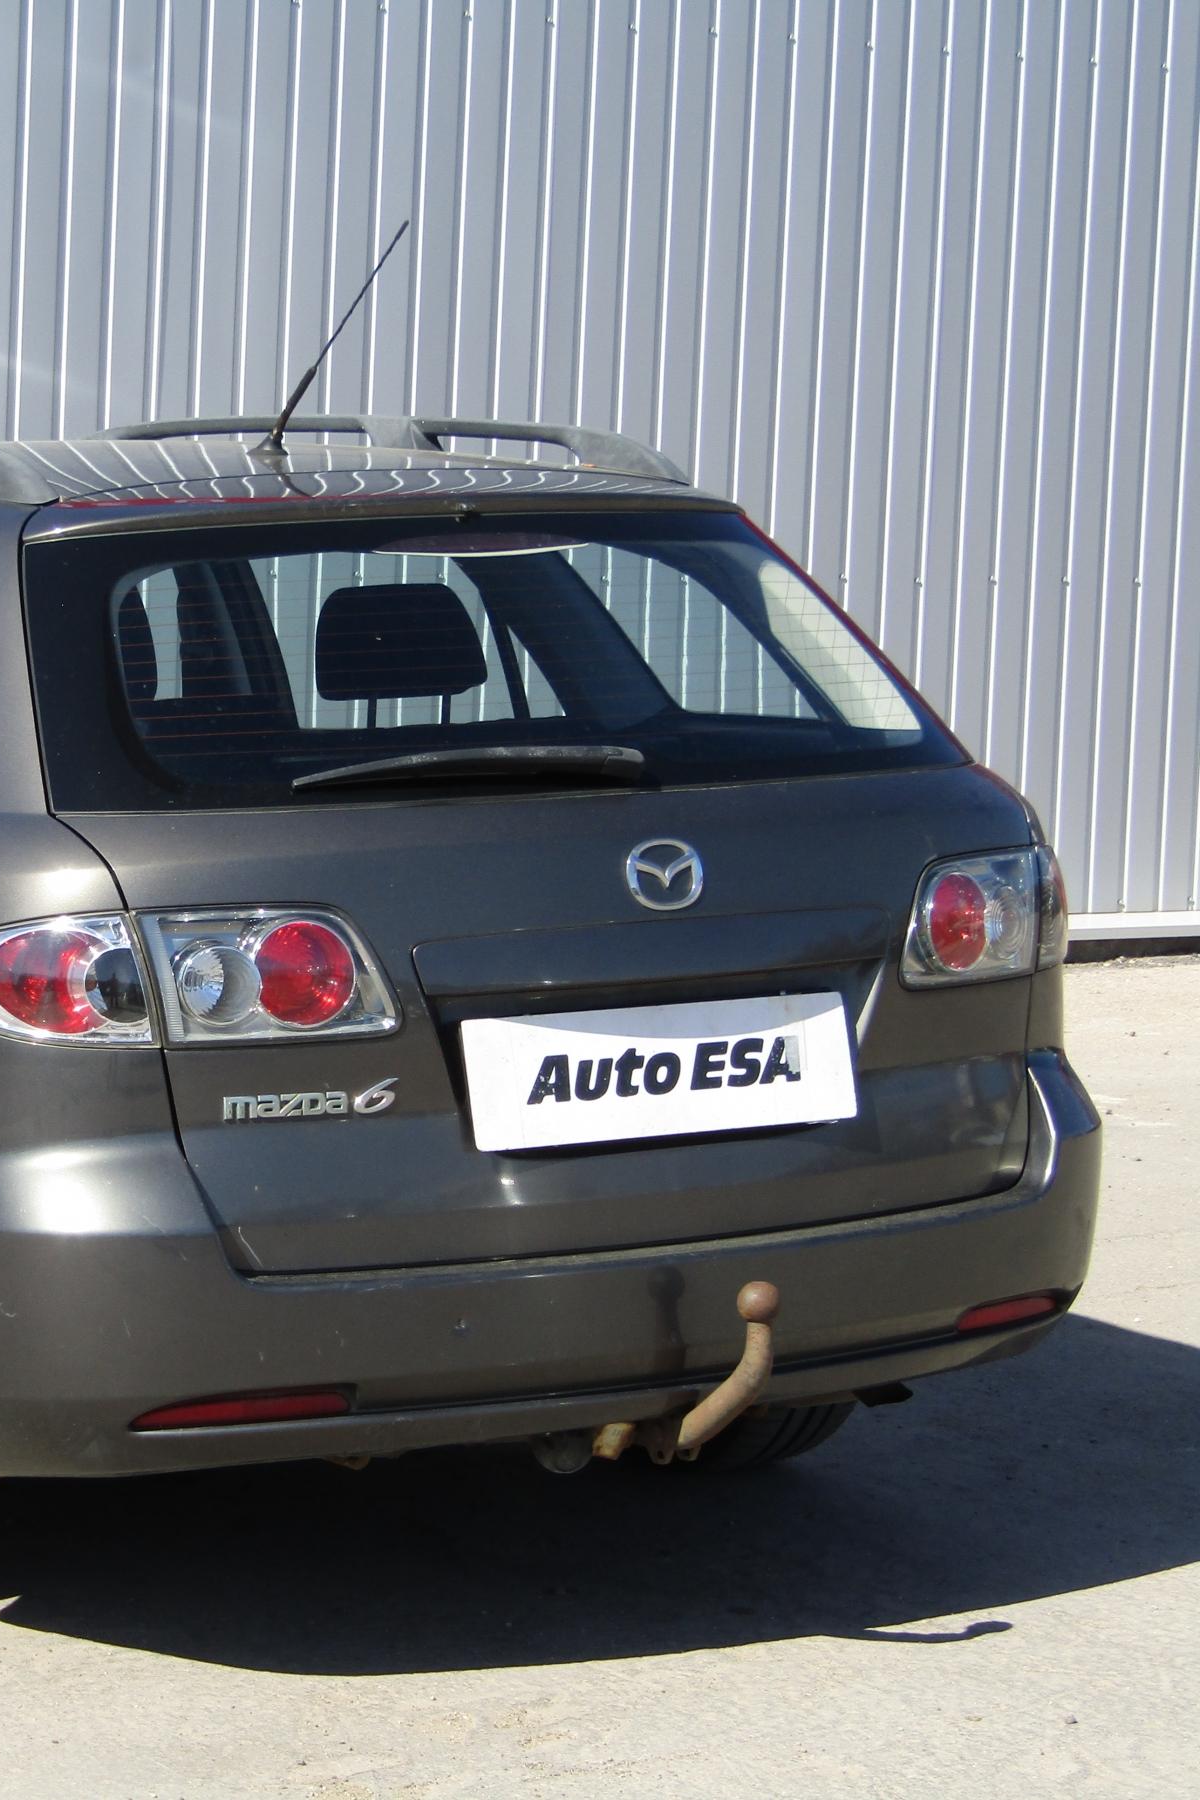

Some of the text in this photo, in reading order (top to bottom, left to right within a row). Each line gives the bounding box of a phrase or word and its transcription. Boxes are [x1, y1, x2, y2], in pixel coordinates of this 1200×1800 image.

[527, 1035, 801, 1105] Auto ESA
[223, 1077, 399, 1120] mazda 6
